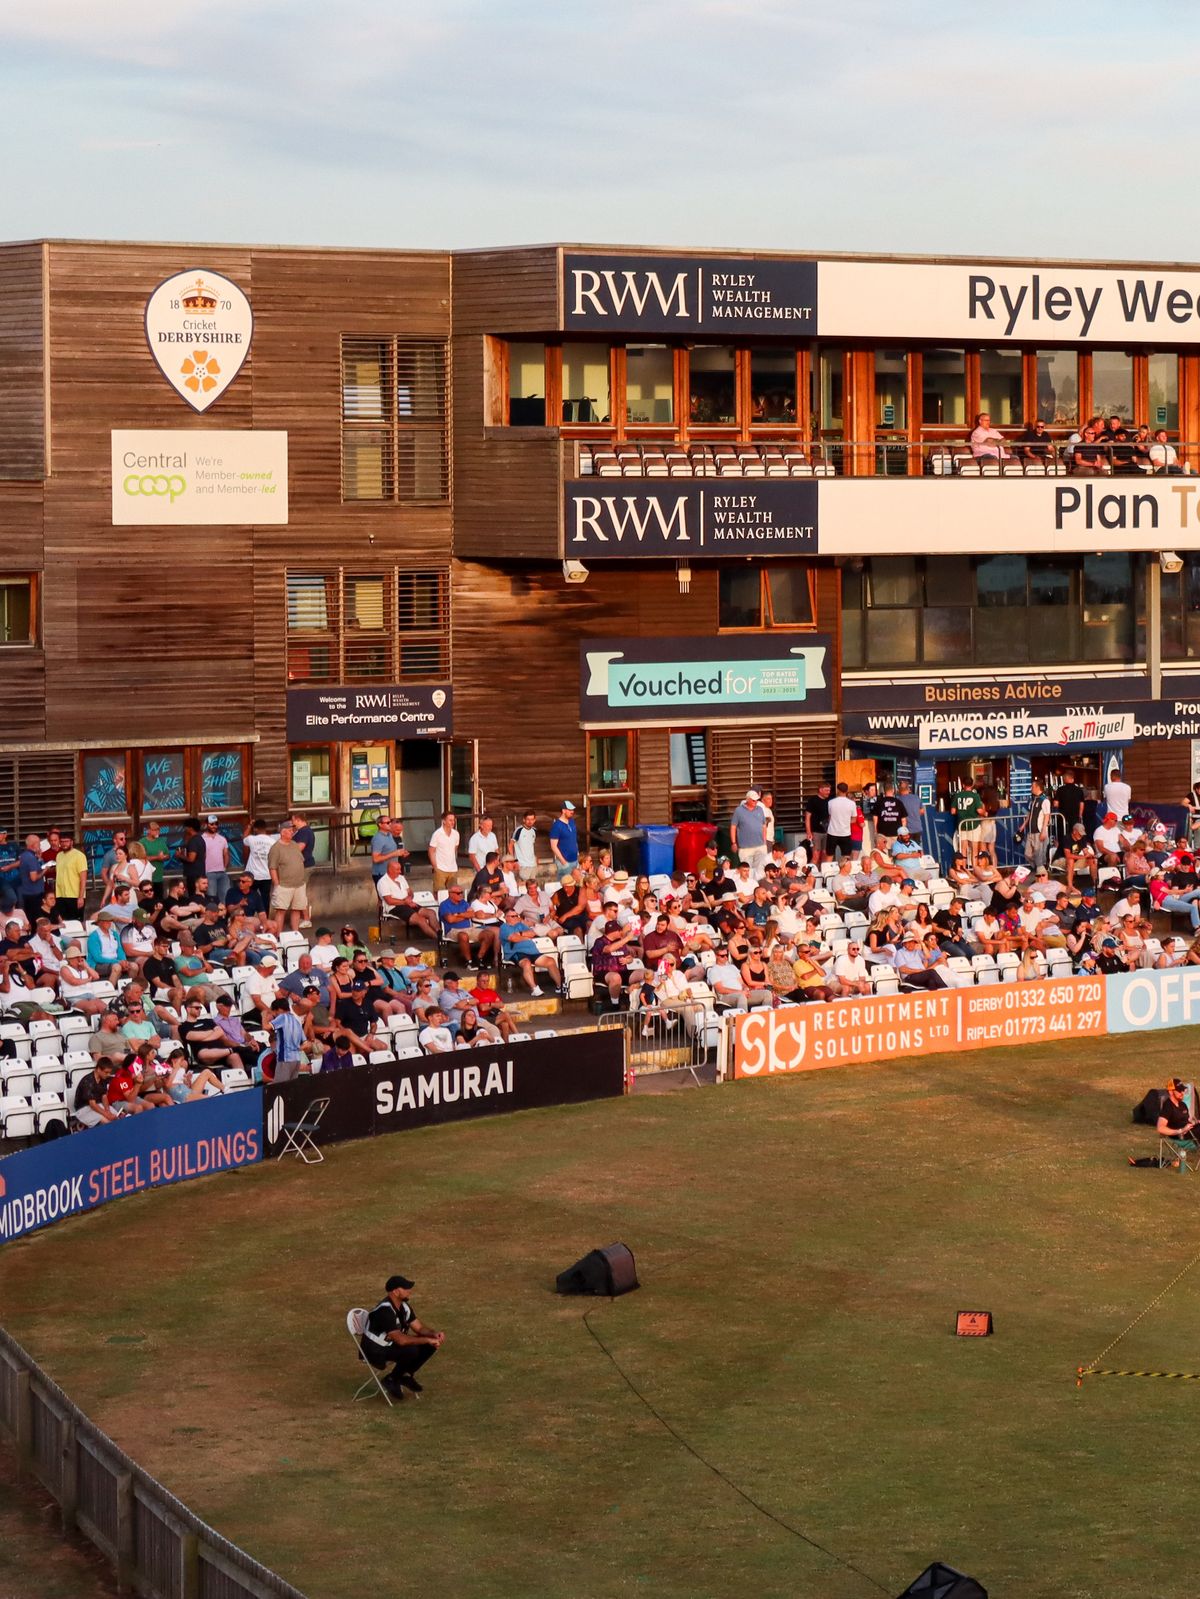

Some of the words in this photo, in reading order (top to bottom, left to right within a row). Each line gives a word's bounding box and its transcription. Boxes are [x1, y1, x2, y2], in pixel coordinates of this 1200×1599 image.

[712, 274, 755, 287] RYLEY
[571, 269, 690, 317] RWM
[712, 290, 771, 303] WEALTH
[170, 300, 180, 311] 18
[220, 300, 232, 311] 70
[712, 306, 812, 320] MANAGEMENT
[969, 275, 1103, 337] Ryley
[183, 319, 217, 331] Cricket
[158, 332, 243, 344] DERBYSHIRE
[123, 451, 187, 468] Central
[123, 474, 187, 503] coop
[195, 484, 214, 494] and
[714, 496, 757, 508] RYLEY
[1055, 484, 1159, 530] Plan
[572, 497, 690, 541] RWM
[714, 512, 773, 523] WEALTH
[714, 527, 814, 540] MANAGEMENT
[925, 684, 1000, 702] Business
[1005, 682, 1062, 700] Advice
[355, 695, 387, 708] RWM
[306, 715, 329, 725] Elite
[331, 713, 398, 725] Performance
[400, 711, 435, 723] Centre
[929, 726, 1008, 743] FALCONS
[1013, 724, 1048, 738] BAR
[146, 758, 173, 776] WE
[203, 755, 241, 773] DERBY
[151, 776, 182, 793] ARE
[203, 770, 240, 790] SHIRE
[969, 997, 1003, 1013] DERBY
[1005, 988, 1045, 1009] 01332
[1049, 985, 1075, 1006] 650
[1078, 983, 1101, 1002] 720
[814, 997, 949, 1031] RECRUITMENT
[967, 1025, 1003, 1041] RIPLEY
[1005, 1016, 1045, 1037] 01773
[1049, 1013, 1072, 1033] 441
[1077, 1011, 1101, 1030] 297
[814, 1029, 923, 1060] SOLUTIONS
[930, 1024, 949, 1038] LTD
[376, 1060, 514, 1115] SAMURAI
[89, 1156, 146, 1203] STEEL
[150, 1128, 258, 1183] BUILDINGS
